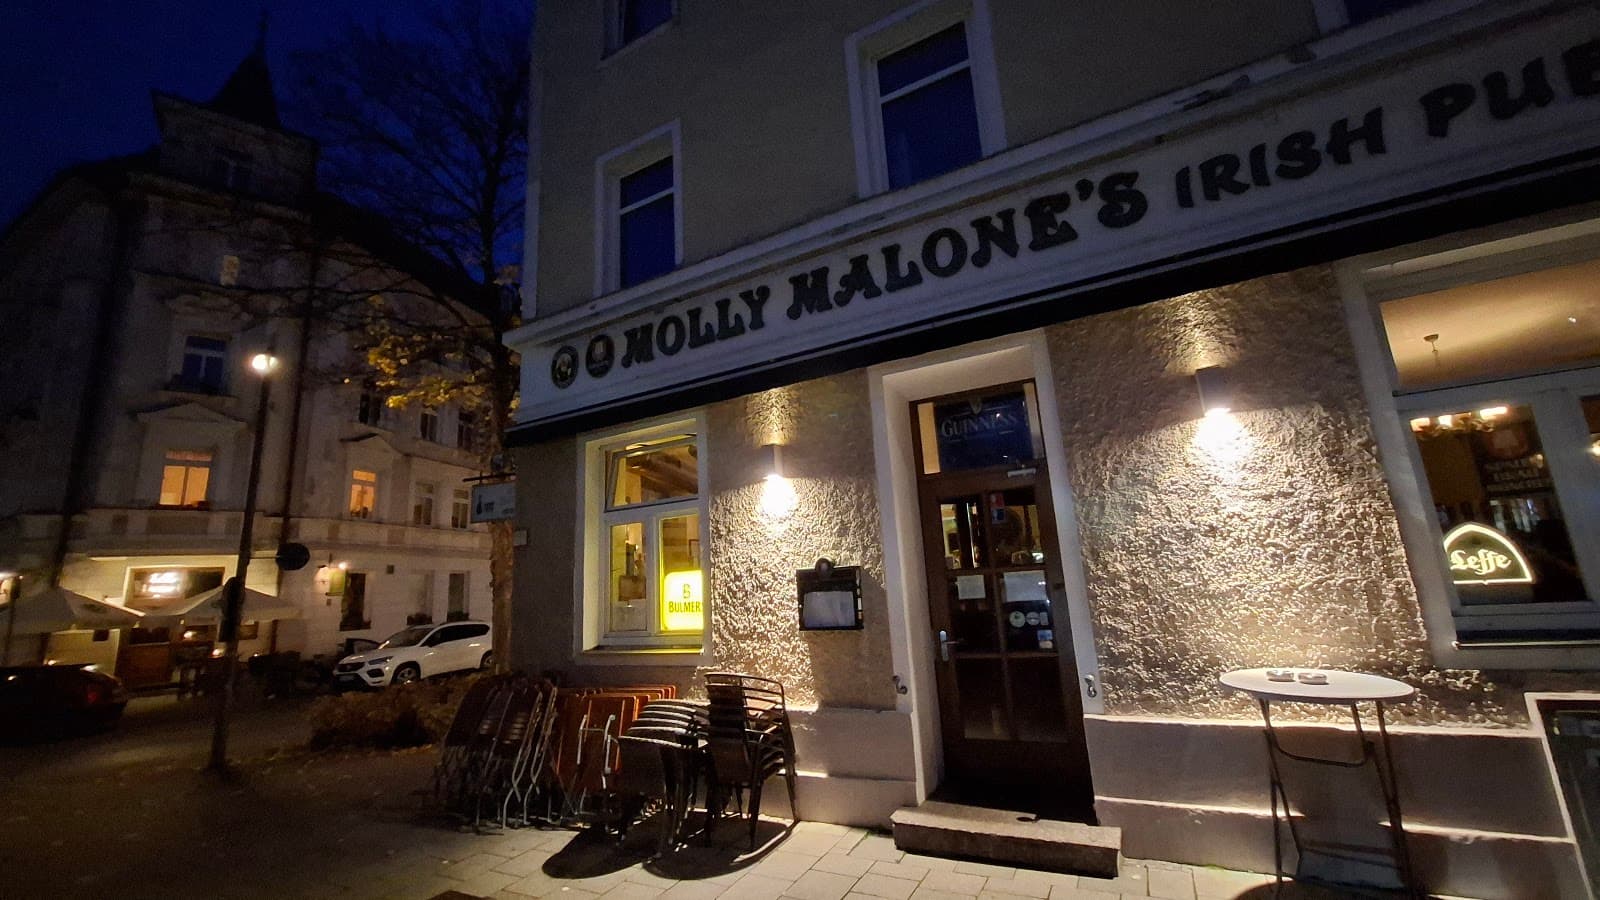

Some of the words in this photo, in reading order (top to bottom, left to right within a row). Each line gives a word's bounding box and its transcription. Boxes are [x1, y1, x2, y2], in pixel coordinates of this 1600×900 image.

[621, 285, 771, 368] MOLLY
[787, 171, 1148, 320] MALONE'S
[1176, 107, 1386, 208] IRISH
[941, 412, 1019, 438] GUINNESS
[1450, 548, 1512, 575] Leffe
